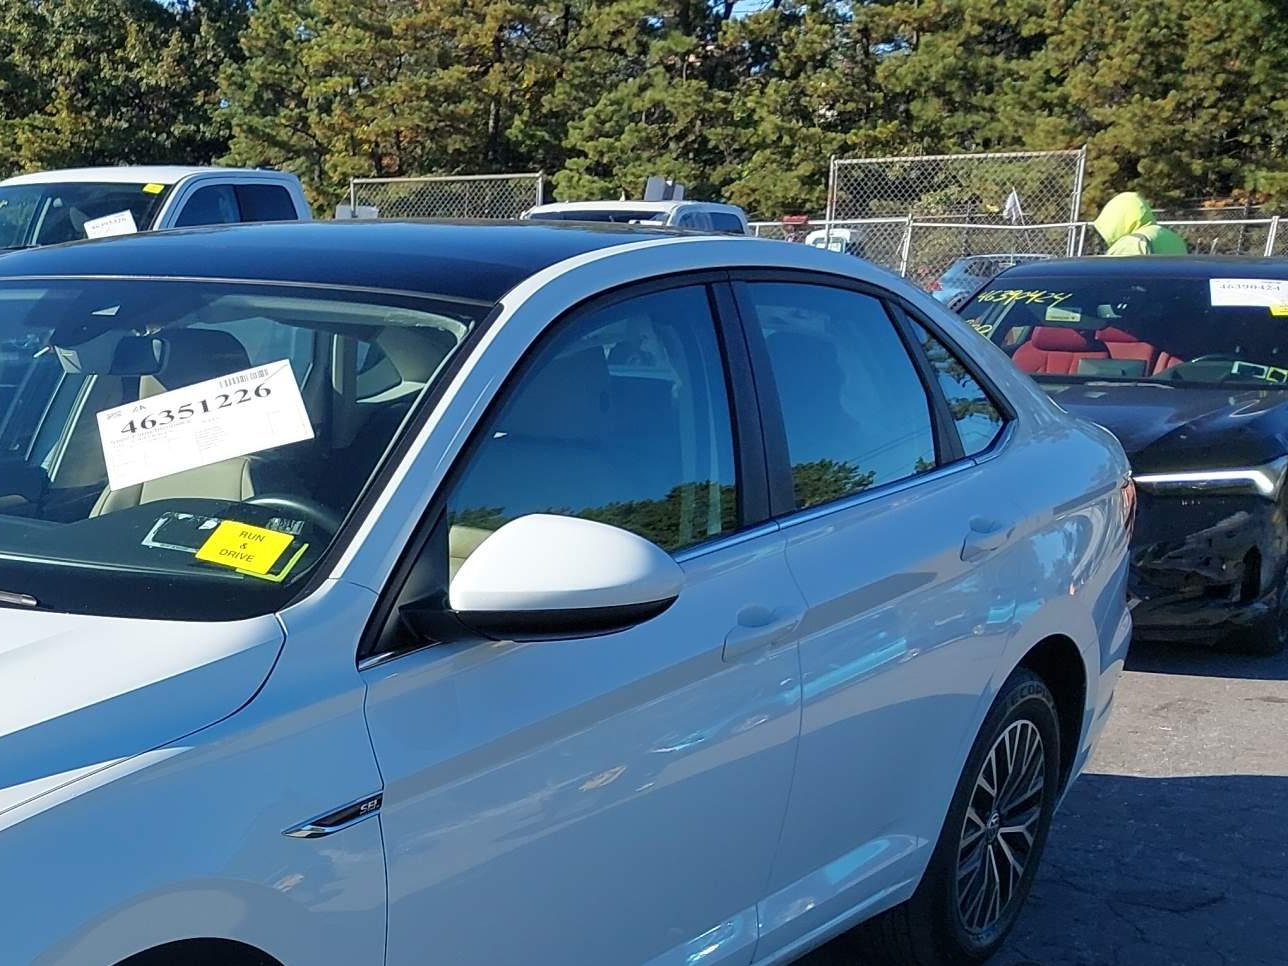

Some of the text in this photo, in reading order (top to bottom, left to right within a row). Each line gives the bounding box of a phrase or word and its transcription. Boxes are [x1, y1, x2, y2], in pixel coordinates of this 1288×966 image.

[120, 383, 272, 434] 46351226
[239, 530, 266, 542] RUN
[219, 548, 255, 562] DRIVE
